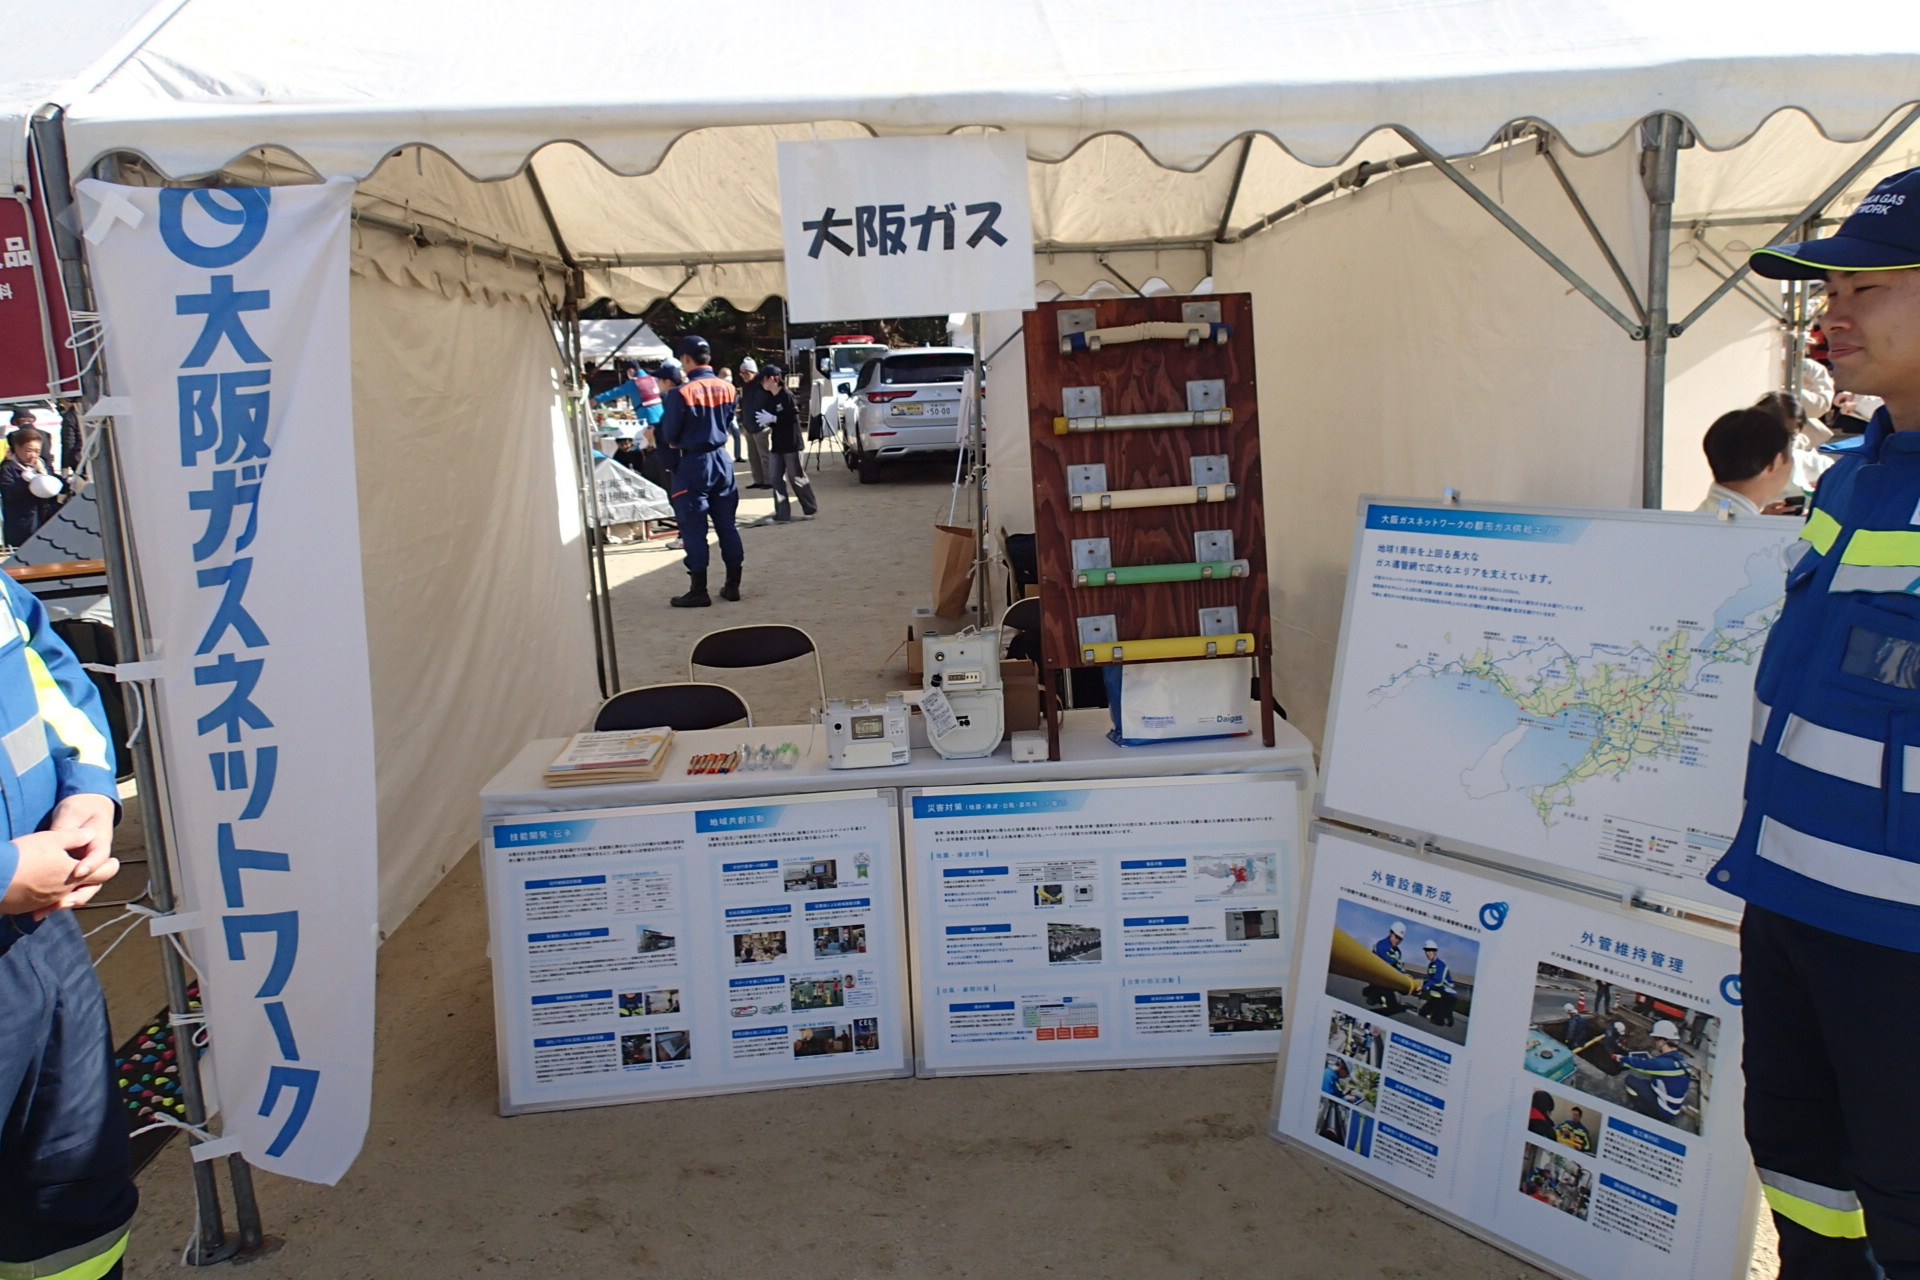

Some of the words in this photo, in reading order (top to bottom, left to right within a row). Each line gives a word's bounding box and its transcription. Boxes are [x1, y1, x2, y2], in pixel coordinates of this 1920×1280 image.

[1880, 194, 1906, 206] GAS
[802, 201, 1008, 260] 大阪ガス
[1380, 514, 1563, 537] 大阪ガスネットワークの都市ガス供給エリア
[1376, 544, 1480, 562] 地球1周半を上回る長大な
[1375, 558, 1553, 585] ガス導管網で広大なエリアを支えています。
[176, 274, 320, 1158] 大阪ガスネットワーク
[1216, 713, 1243, 723] Daigas
[927, 802, 963, 813] 災害対策
[709, 814, 766, 827] 地域共創活動
[509, 829, 572, 842] 技能開発・伝承
[1370, 870, 1452, 905] 外管設備形成
[1580, 931, 1685, 974] 外管維持管理
[858, 1019, 873, 1027] CEL
